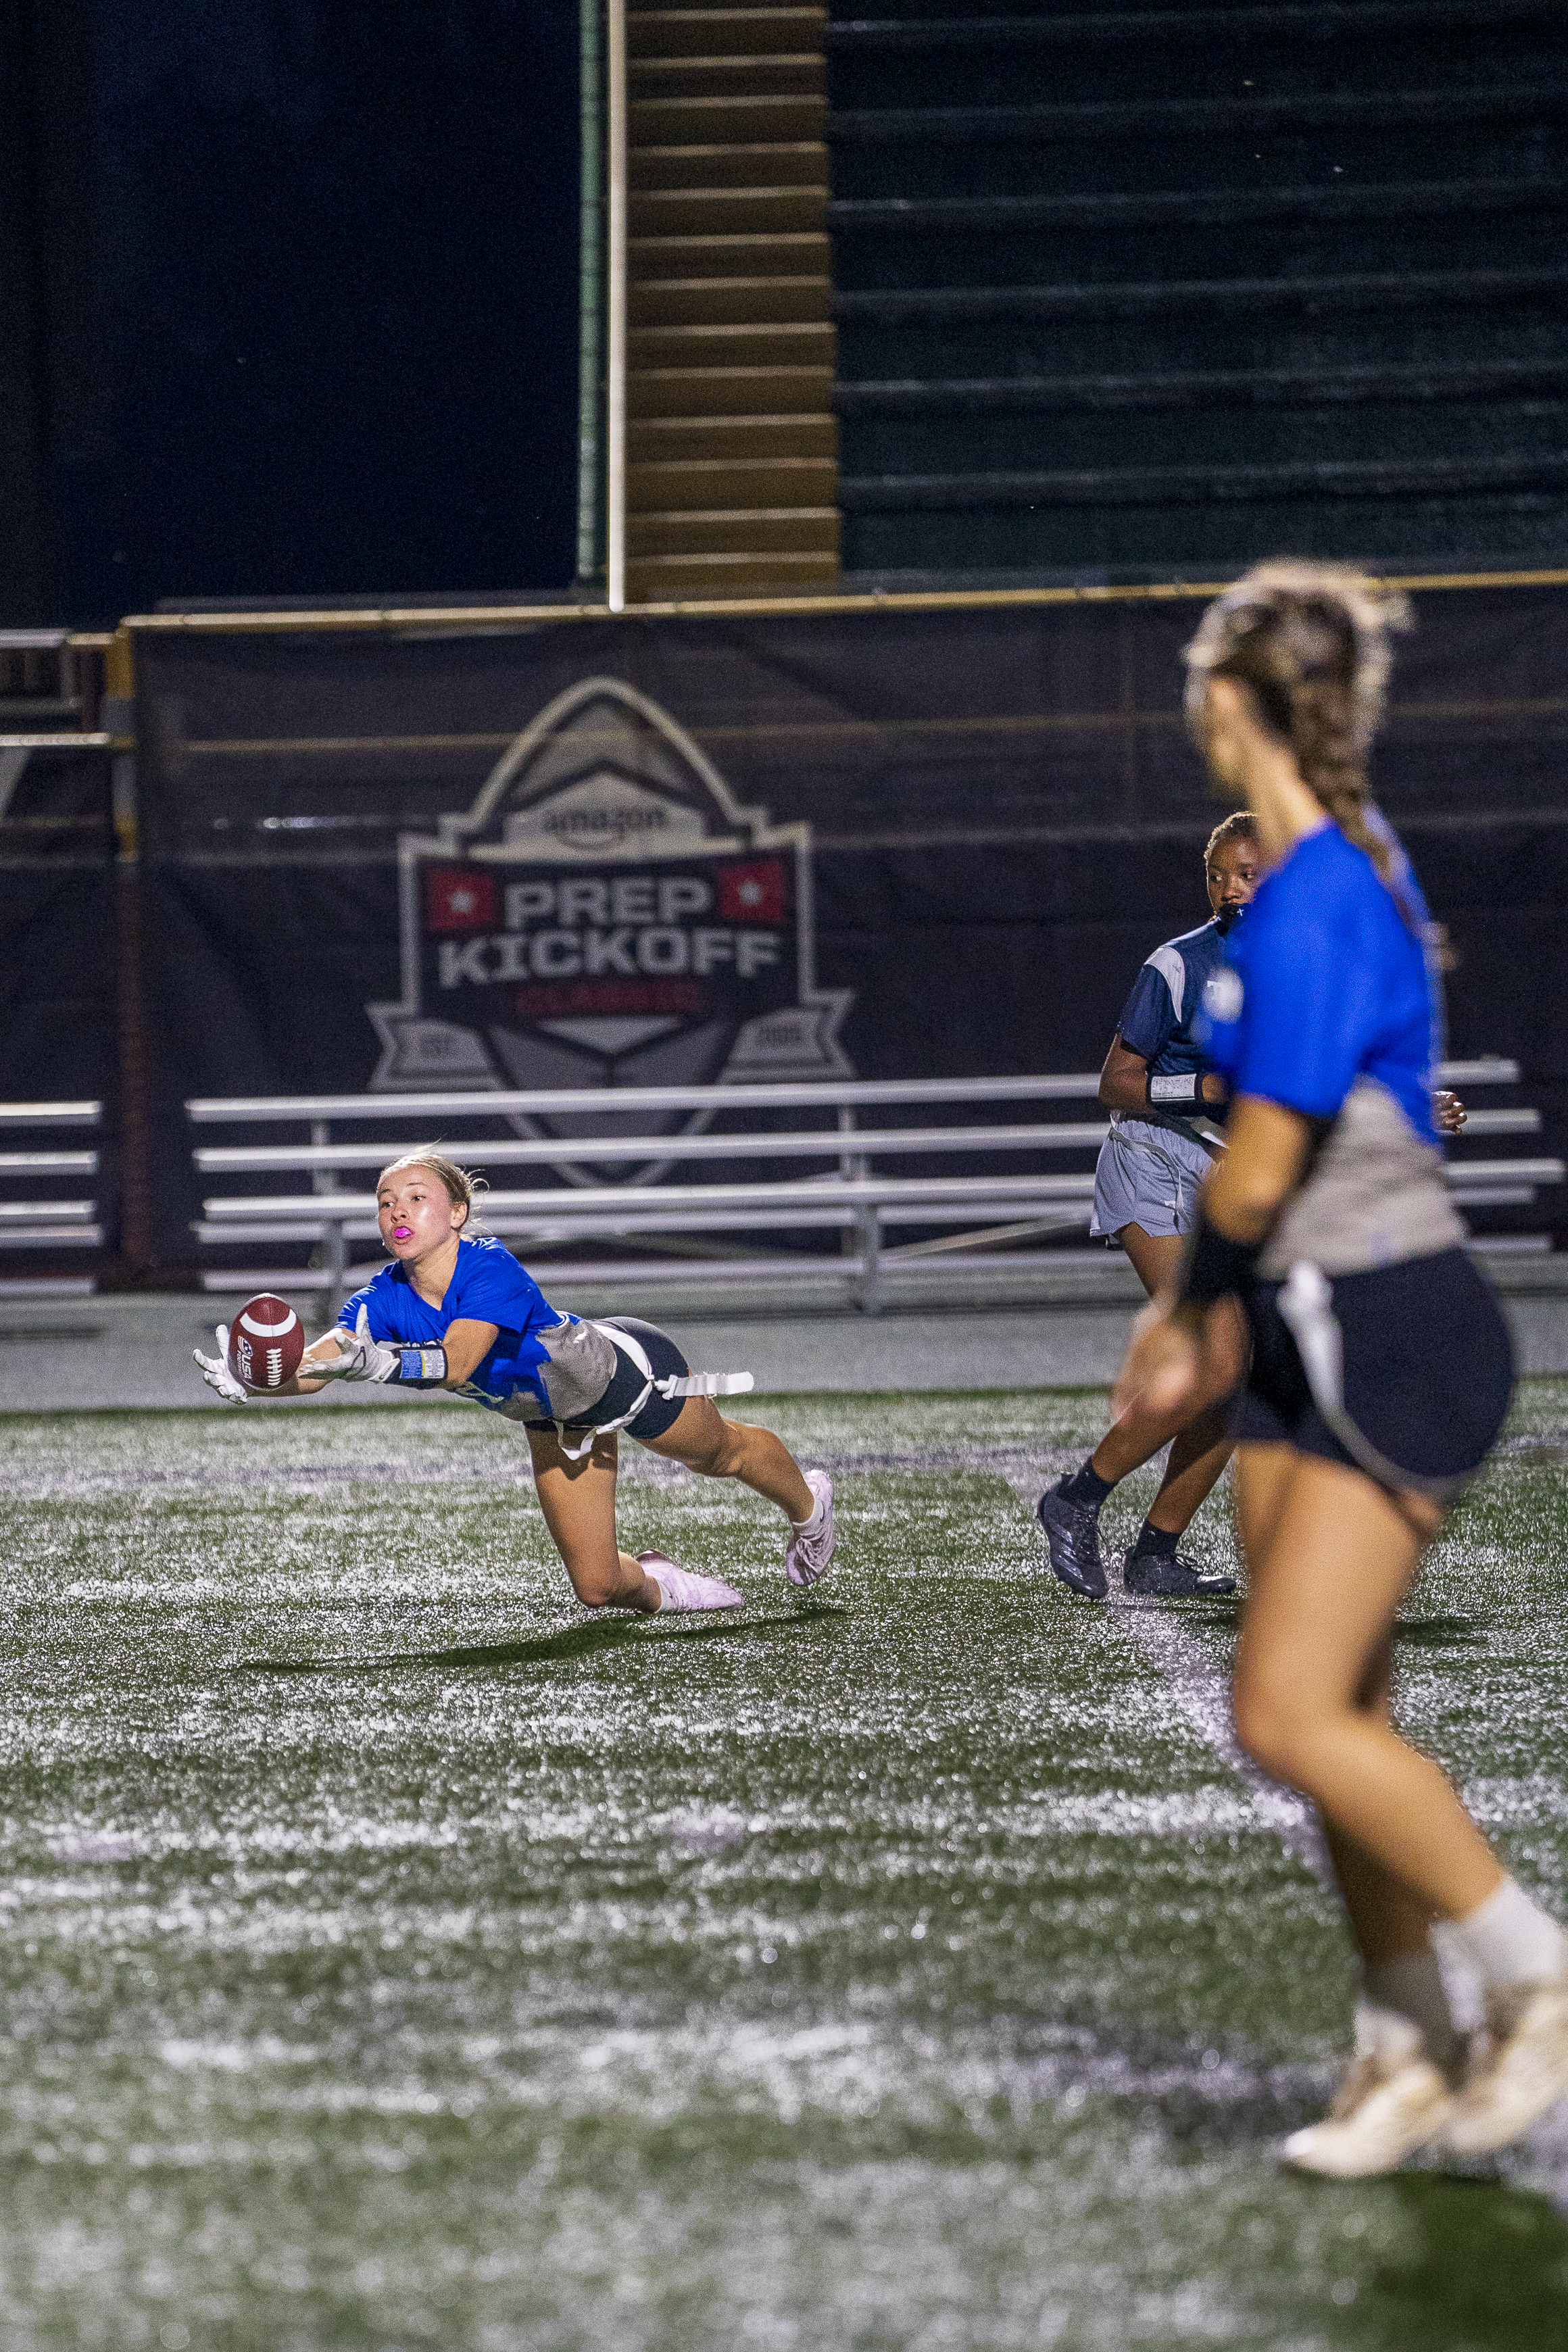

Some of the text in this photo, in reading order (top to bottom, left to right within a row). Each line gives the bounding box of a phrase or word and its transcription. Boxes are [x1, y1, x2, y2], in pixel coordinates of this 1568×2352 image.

[543, 806, 669, 833] amazon
[504, 877, 712, 929] PREP
[439, 927, 781, 989] KICKOFF
[242, 1354, 252, 1379] USA
